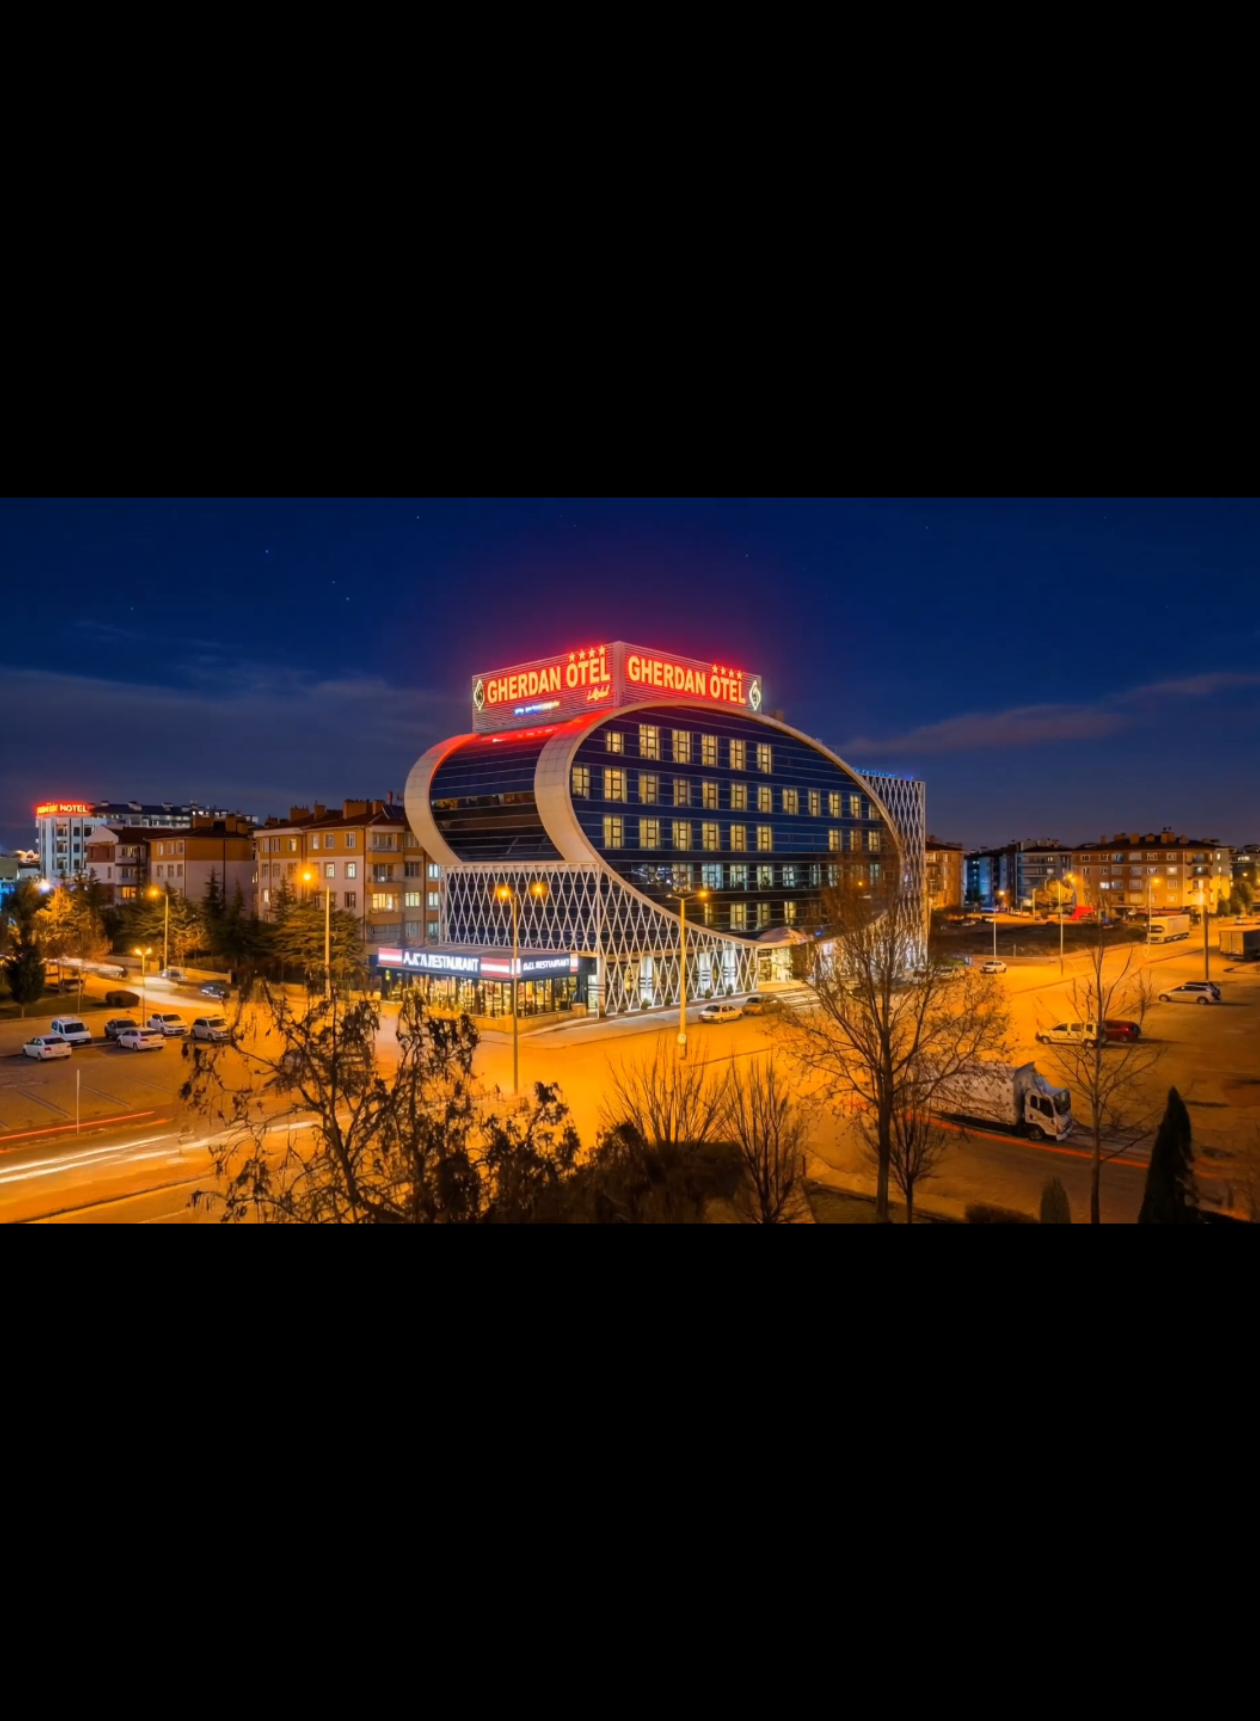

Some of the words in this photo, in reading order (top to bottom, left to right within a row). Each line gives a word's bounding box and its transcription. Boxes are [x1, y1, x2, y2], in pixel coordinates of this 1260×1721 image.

[487, 666, 562, 704] GHERDAN
[566, 656, 611, 688] OTEL
[628, 656, 706, 696] GHERDAN
[710, 674, 747, 705] OTEL
[59, 803, 88, 813] HOTEL
